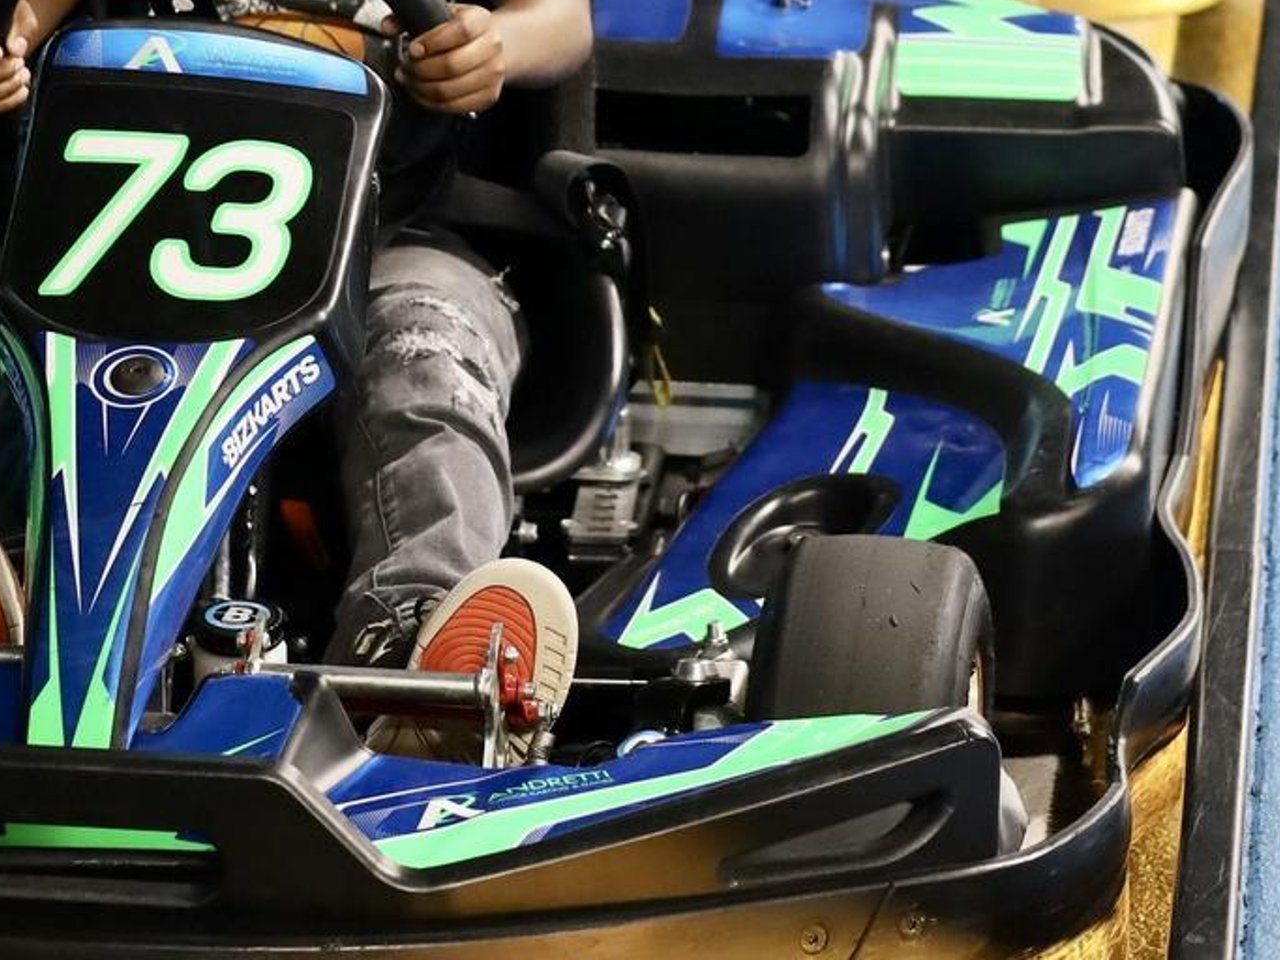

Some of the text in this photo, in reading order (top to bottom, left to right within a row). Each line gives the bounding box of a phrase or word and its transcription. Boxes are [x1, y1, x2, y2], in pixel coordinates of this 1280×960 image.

[38, 129, 313, 301] 73
[221, 354, 321, 469] BIZKARTS
[221, 606, 254, 622] B
[488, 769, 610, 804] ANDRETTI
